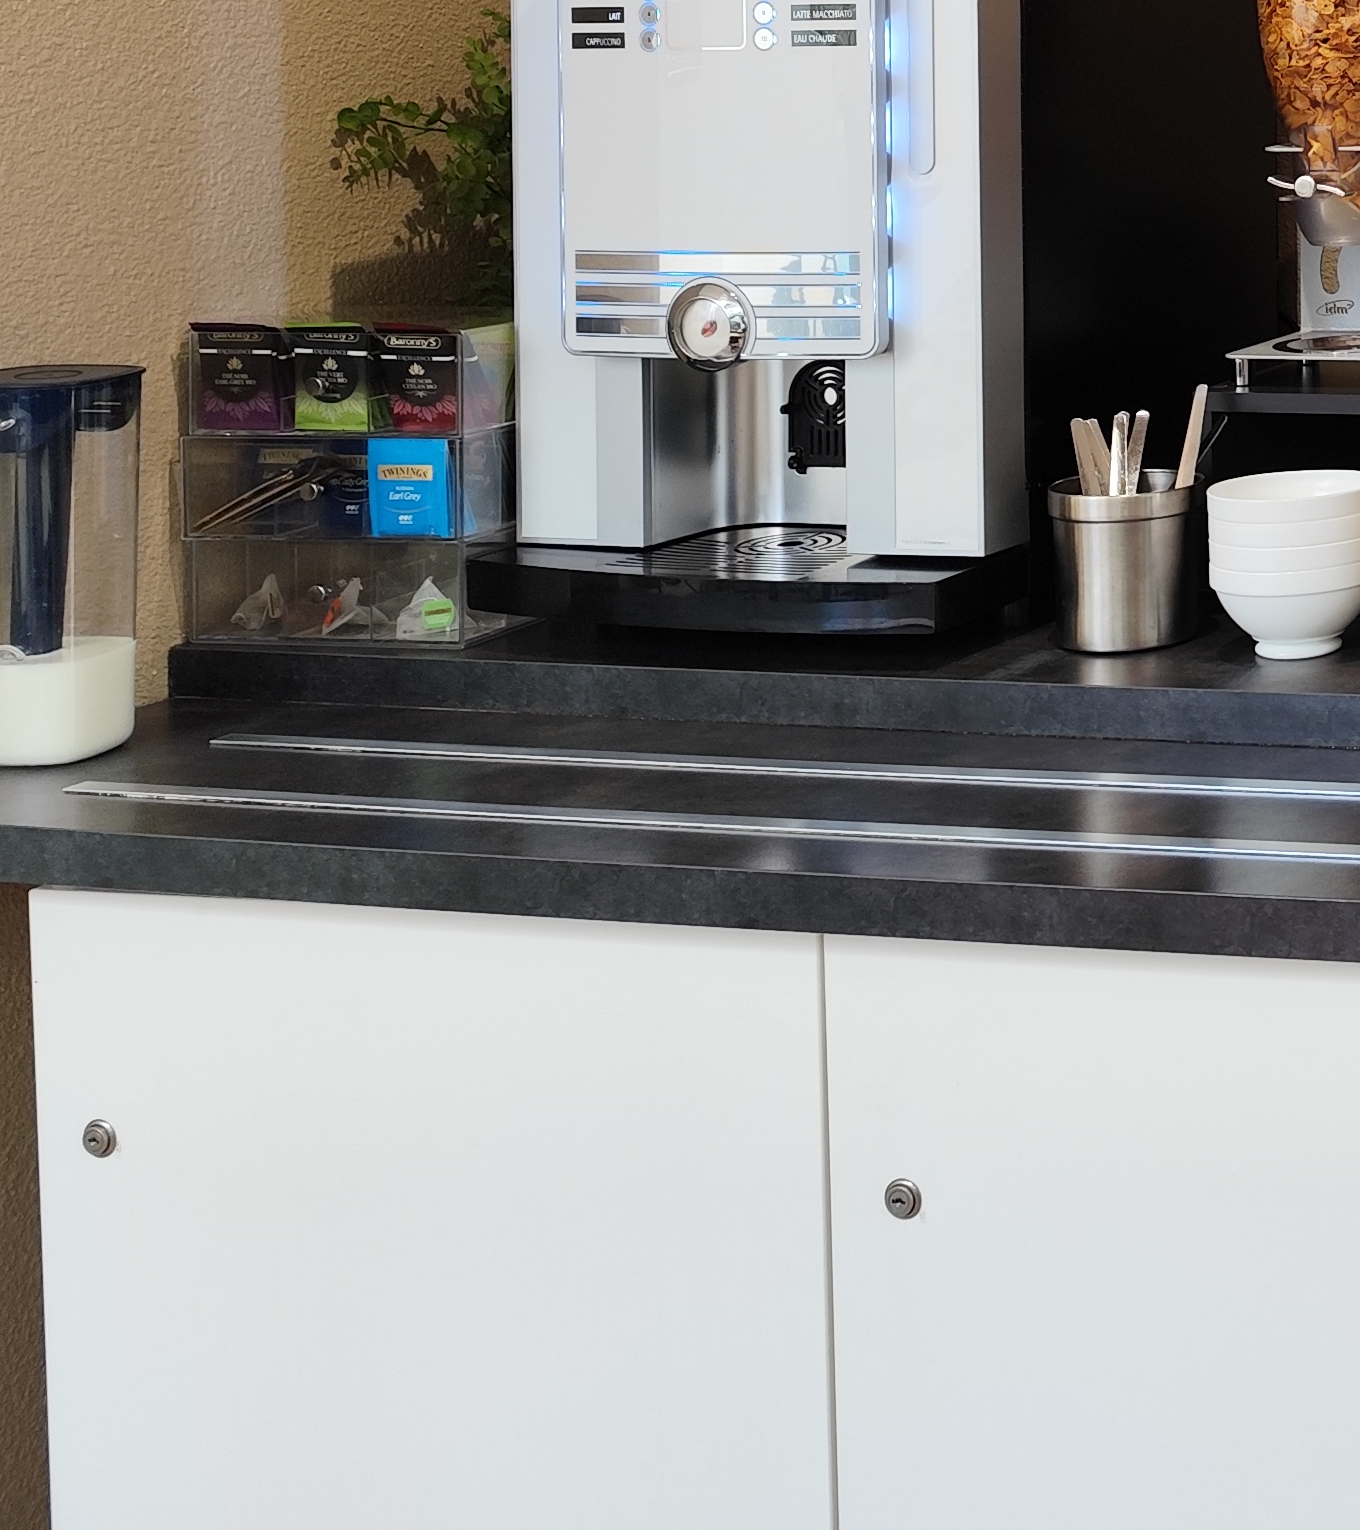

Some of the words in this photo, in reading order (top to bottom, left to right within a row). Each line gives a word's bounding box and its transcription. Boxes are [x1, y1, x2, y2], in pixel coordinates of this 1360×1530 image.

[585, 37, 621, 46] CAPPUCCINO
[1325, 303, 1348, 314] idm
[381, 466, 429, 479] TWININGS
[388, 491, 404, 501] Earl
[403, 491, 422, 503] Grey
